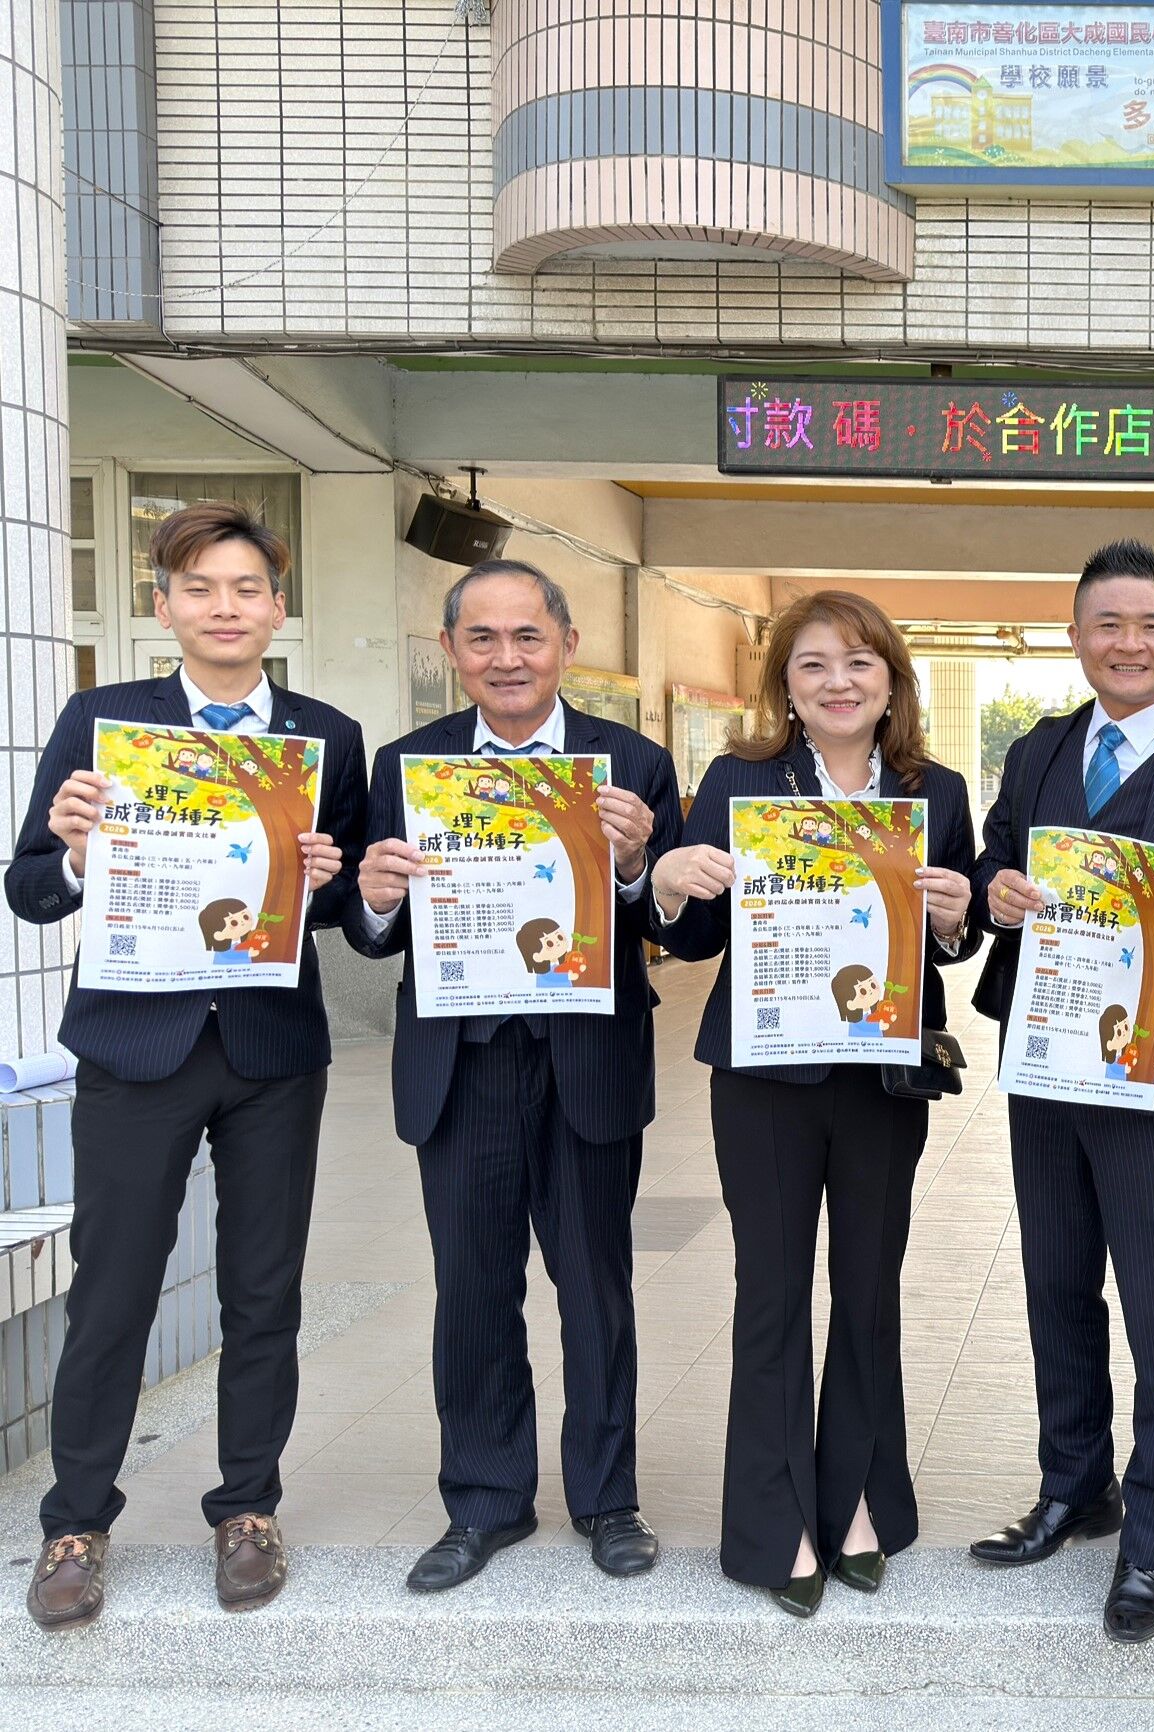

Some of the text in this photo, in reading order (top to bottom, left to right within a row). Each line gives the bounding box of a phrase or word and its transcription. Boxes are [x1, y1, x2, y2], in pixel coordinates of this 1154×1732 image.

[924, 48, 953, 56] Tainan
[955, 48, 997, 57] Municipal
[999, 48, 1038, 56] Shanhua
[1039, 48, 1071, 56] District
[1073, 48, 1111, 57] Dacheng
[1000, 64, 1109, 88] 學校願景
[145, 785, 189, 805] 埋下
[104, 802, 223, 826] 誠實的種子
[453, 813, 491, 831] 埋下
[419, 831, 525, 852] 誠實的種子
[777, 855, 813, 873] 埋下
[743, 874, 844, 895] 誠實的種子
[1067, 885, 1100, 905] 埋下
[1037, 902, 1119, 929] 誠實的種子
